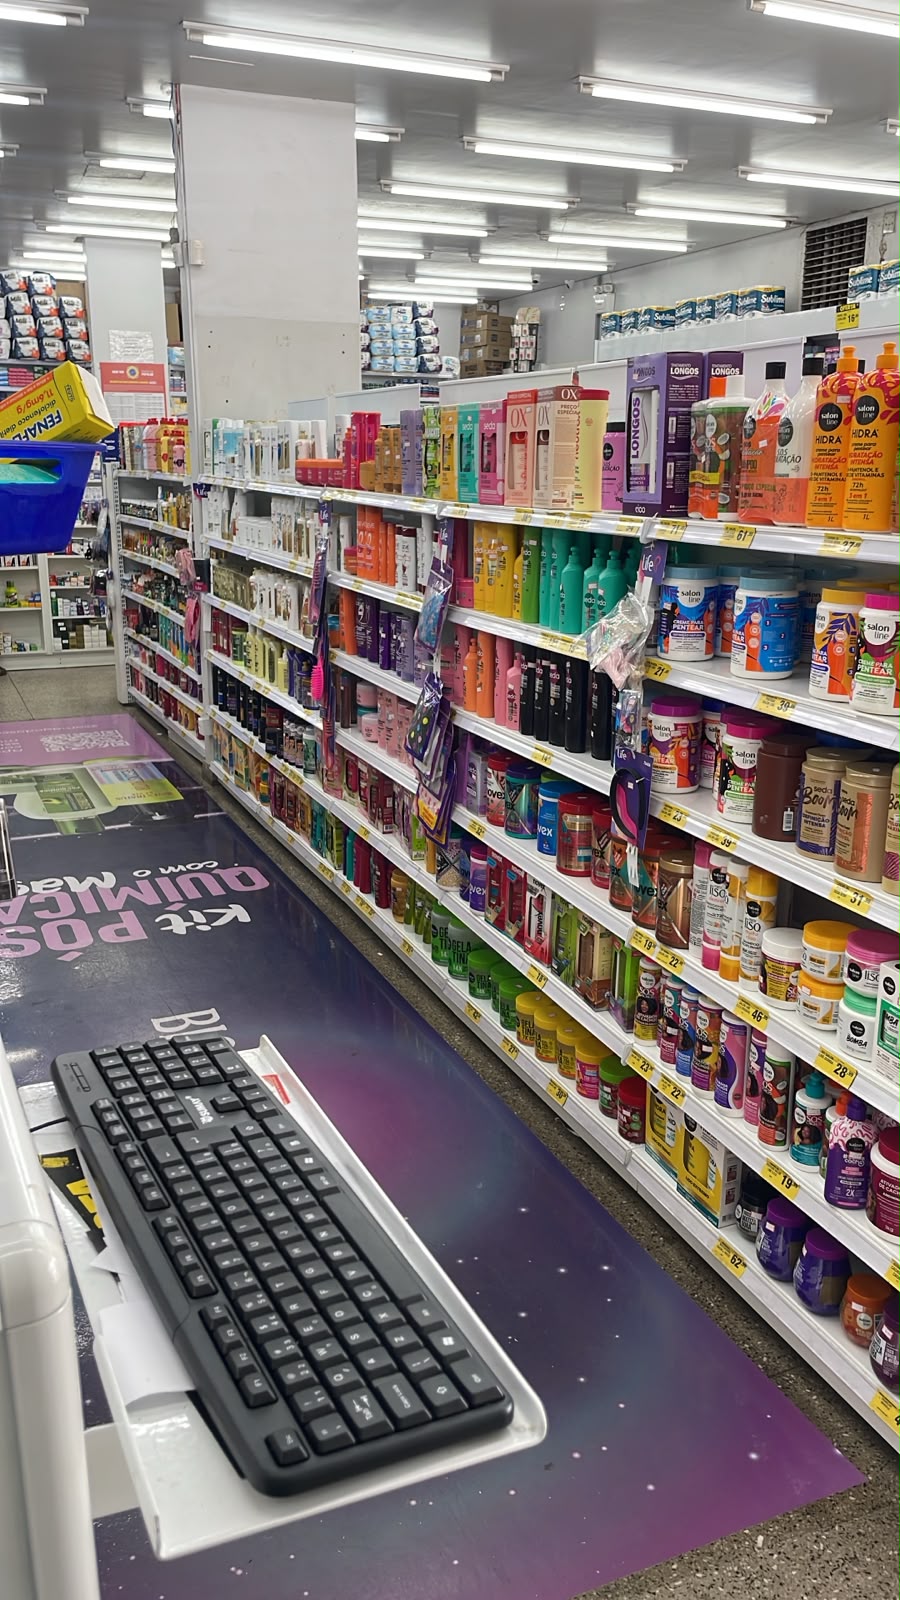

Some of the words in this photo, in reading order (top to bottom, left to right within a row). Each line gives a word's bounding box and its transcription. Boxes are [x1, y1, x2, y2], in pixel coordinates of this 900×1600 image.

[670, 367, 699, 375] LONGOS
[711, 368, 740, 376] LONGOS
[561, 388, 578, 400] OX
[16, 388, 54, 416] 11,6mg/g
[17, 399, 56, 427] diclofenaco
[510, 408, 527, 429] OX
[631, 397, 642, 459] LONGOS
[641, 556, 655, 573] Life
[681, 590, 701, 598] salon
[866, 622, 890, 632] salon
[874, 630, 890, 640] line
[858, 665, 894, 676] PENTEAR
[653, 724, 671, 732] salon
[735, 751, 756, 759] salon
[132, 868, 152, 878] o
[159, 860, 219, 875] com
[0, 865, 270, 926] QUÍMICA
[155, 903, 251, 935] Kit
[0, 910, 149, 962] PÓS
[752, 1010, 764, 1023] 46
[846, 1033, 869, 1048] BOMBA
[781, 1175, 793, 1190] 19
[880, 1178, 900, 1190] ATIVAD
[845, 1188, 855, 1197] 2X
[730, 1254, 743, 1269] 62
